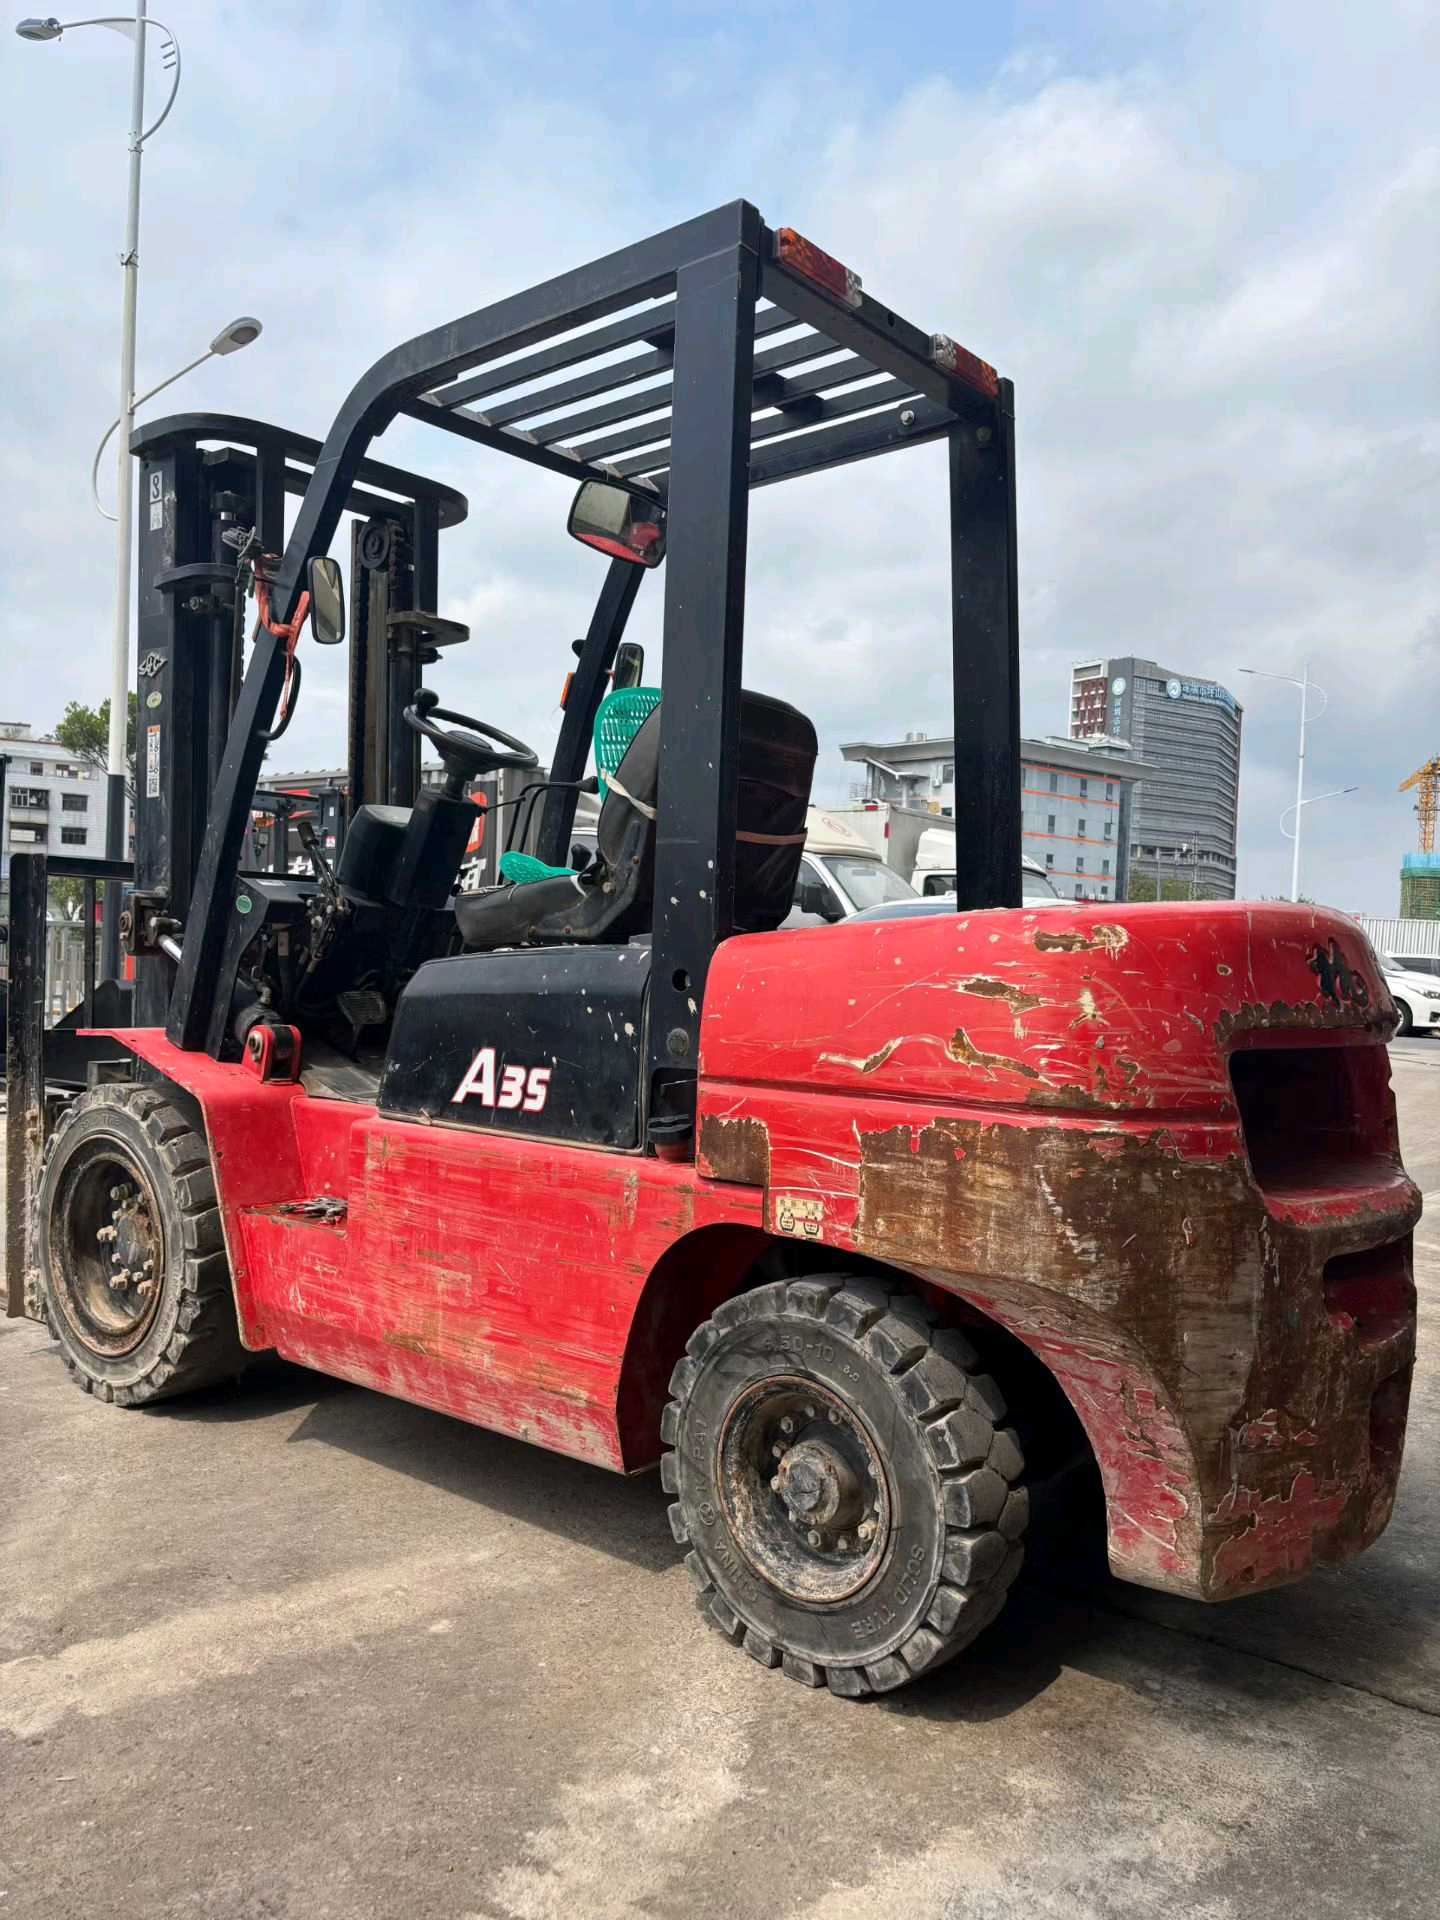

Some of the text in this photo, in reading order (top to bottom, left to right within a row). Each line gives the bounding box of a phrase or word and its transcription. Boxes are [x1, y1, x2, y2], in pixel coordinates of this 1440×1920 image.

[451, 1046, 552, 1113] A35
[851, 1544, 926, 1639] SOLID TYRE
